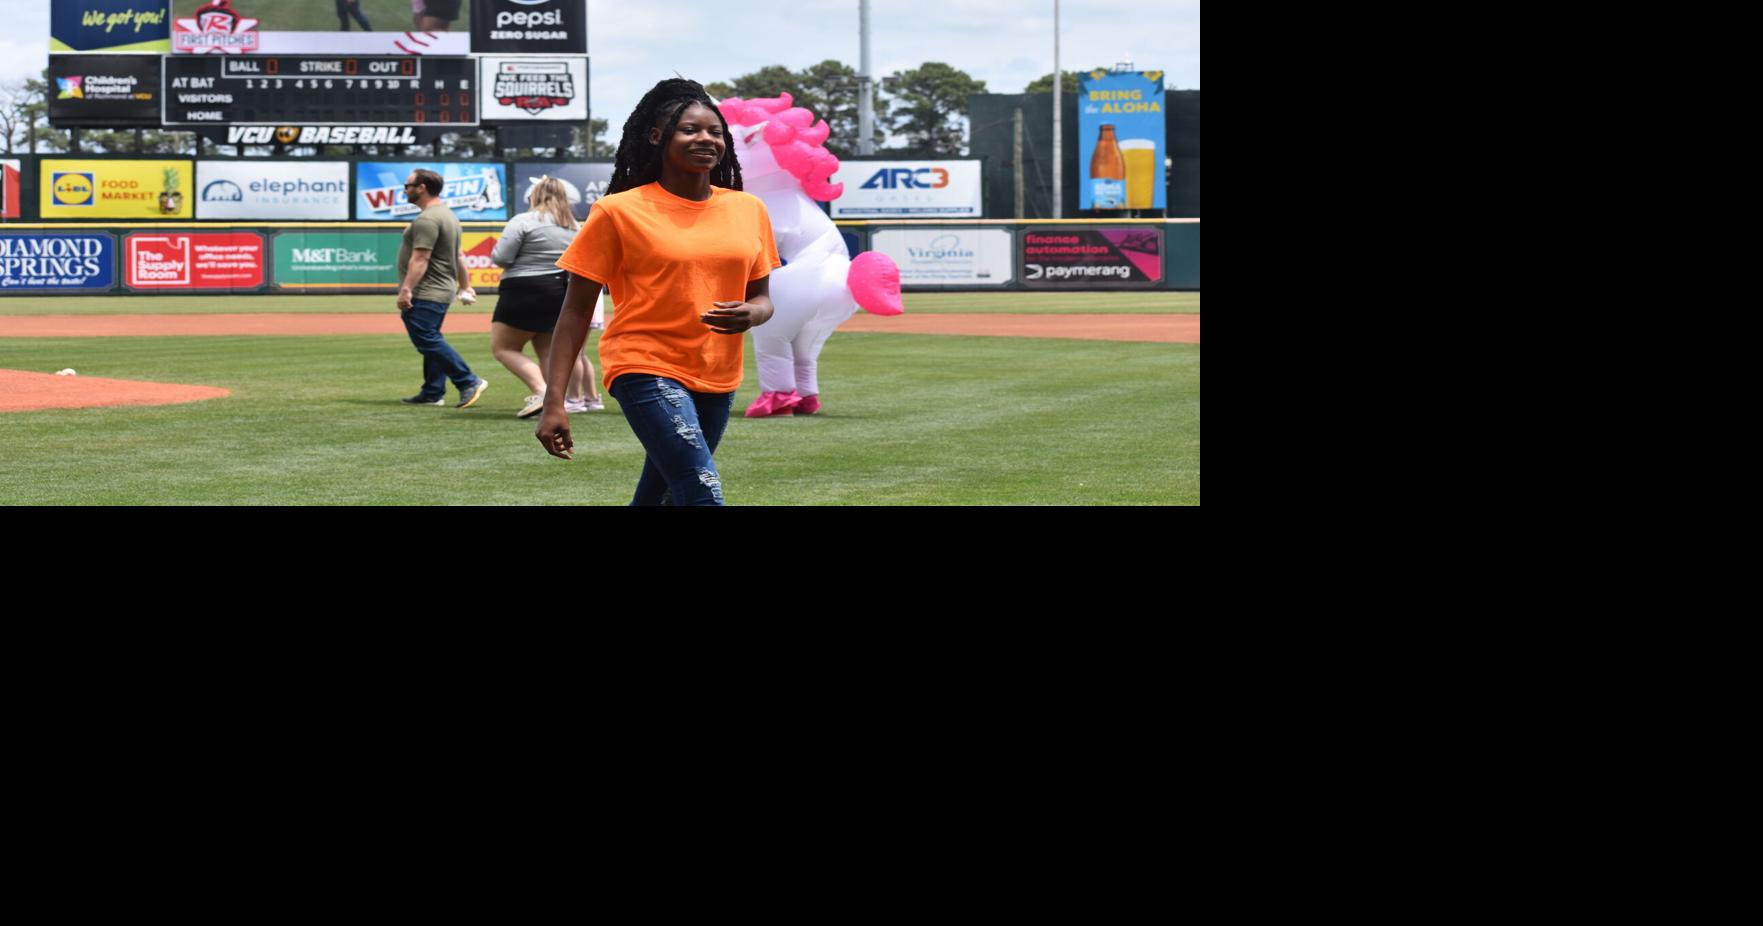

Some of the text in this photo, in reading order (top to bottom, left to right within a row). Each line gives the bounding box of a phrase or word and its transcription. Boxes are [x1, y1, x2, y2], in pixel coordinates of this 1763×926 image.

[82, 8, 165, 32] We got you!
[496, 8, 561, 28] pepsi
[490, 30, 568, 40] ZERO SUGAR
[229, 61, 260, 72] BALL
[300, 61, 342, 72] STRIKE
[369, 62, 398, 72] OUT
[84, 75, 138, 85] Children's
[172, 78, 215, 88] AT BAT
[247, 80, 469, 89] 1 2 3 4 5 6 7 8 9 10 R H E
[84, 85, 131, 94] Hospital
[495, 82, 573, 98] SQUIRRELS
[178, 94, 233, 103] VISITORS
[1089, 90, 1142, 101] BRING
[1101, 102, 1161, 113] ALOHA
[187, 111, 223, 121] HOME
[228, 127, 417, 144] VCU BASEBALL
[859, 168, 949, 189] ARC3
[101, 180, 138, 189] FOOD
[249, 178, 345, 196] elephant
[101, 192, 155, 201] MARKET
[256, 196, 339, 204] INSURANCE
[1025, 235, 1080, 244] finance
[908, 247, 974, 259] Virginia
[1025, 245, 1109, 254] automation
[138, 250, 164, 261] The
[292, 248, 377, 263] M&T Bank
[138, 259, 184, 272] Supply
[138, 269, 177, 279] Room
[1046, 265, 1130, 278] paymerang
